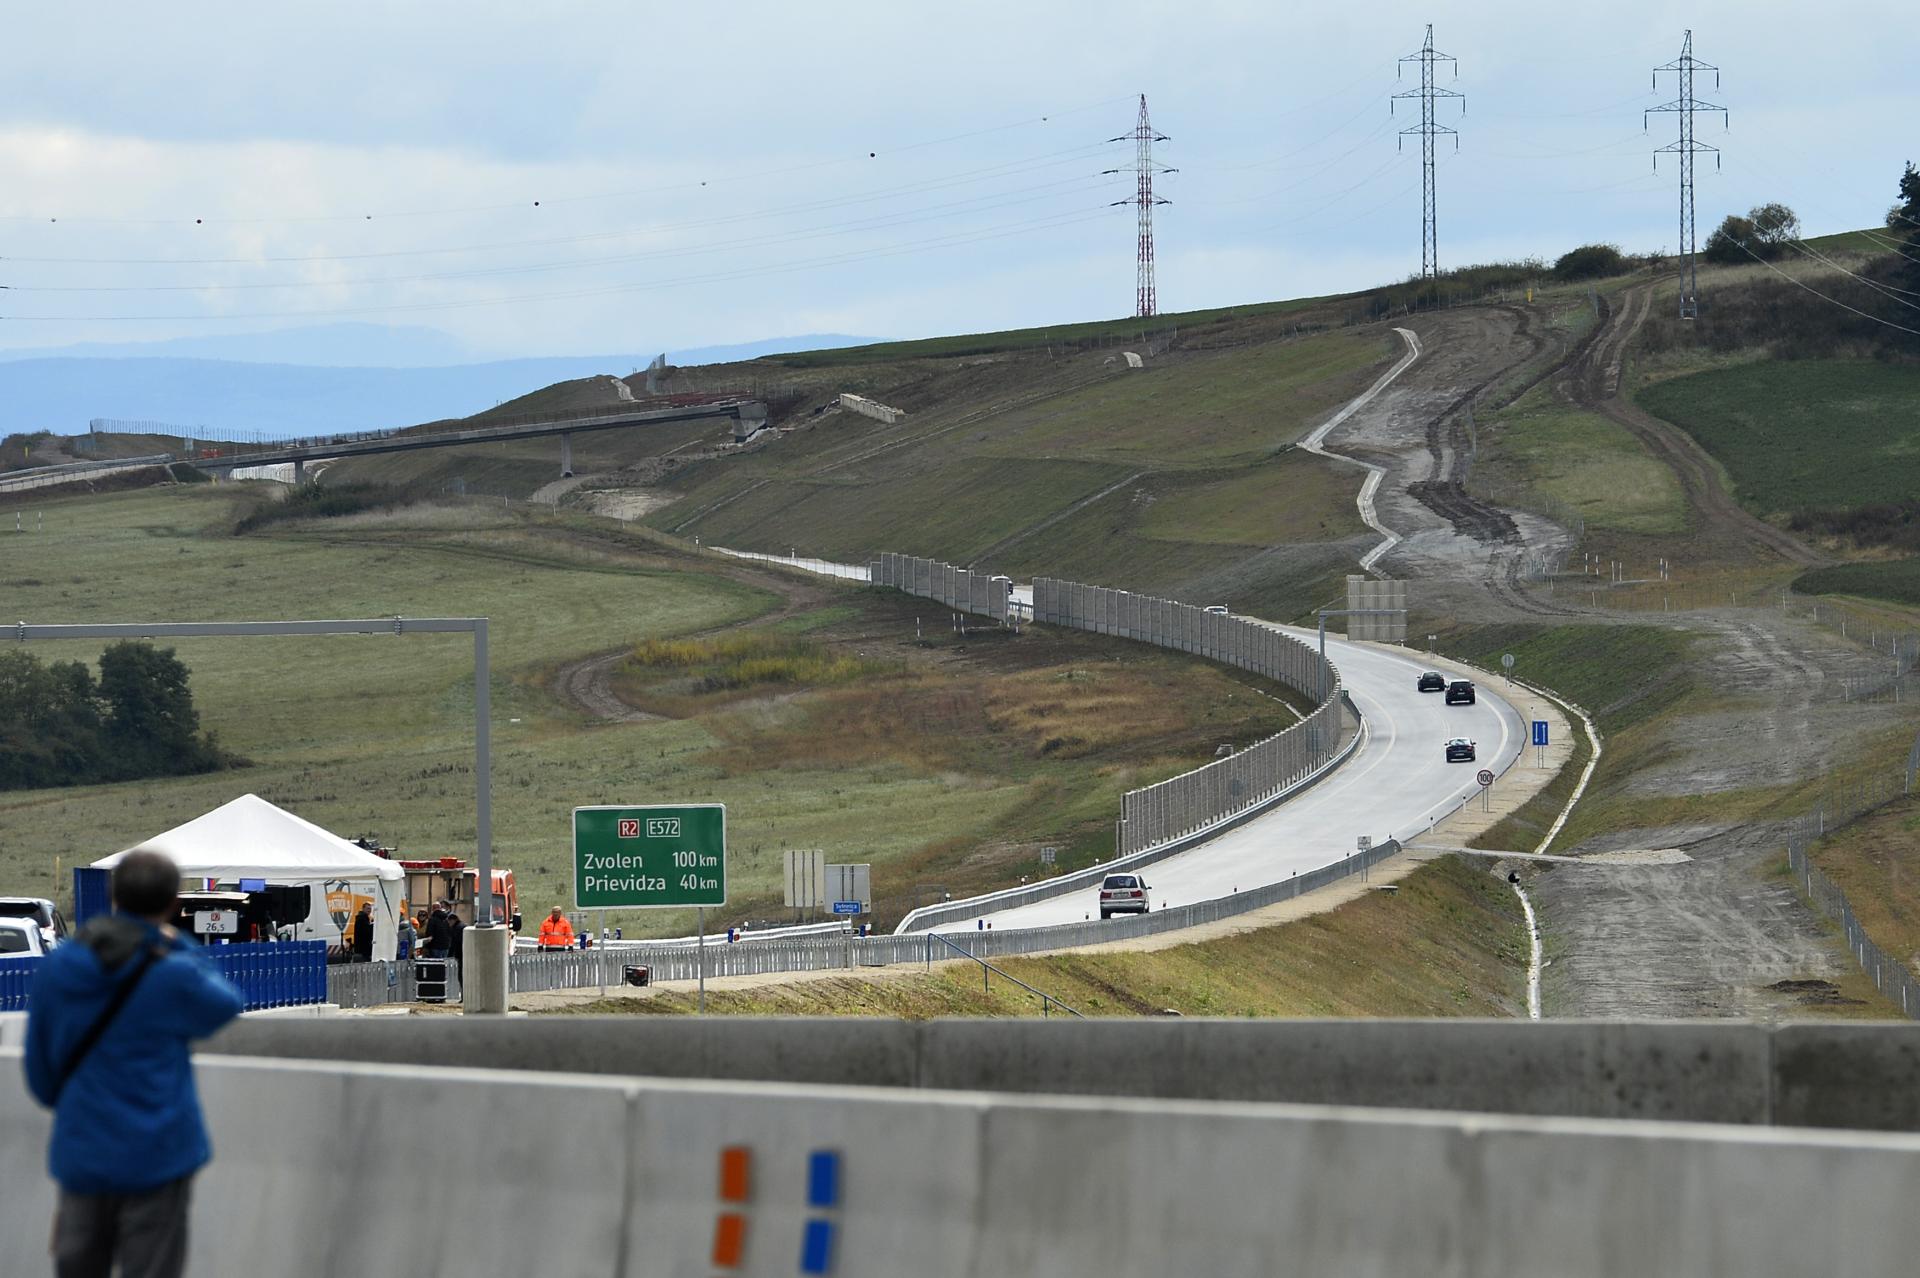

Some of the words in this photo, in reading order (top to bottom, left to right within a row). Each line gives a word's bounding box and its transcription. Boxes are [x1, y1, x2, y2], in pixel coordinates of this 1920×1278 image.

[1480, 773, 1492, 782] 100
[621, 821, 637, 836] R2
[649, 820, 679, 835] E572
[584, 853, 643, 869] Zvolen
[672, 851, 697, 867] 100
[699, 854, 717, 867] km
[585, 874, 666, 892] Prievidza
[680, 874, 697, 890] 40
[700, 877, 718, 890] km
